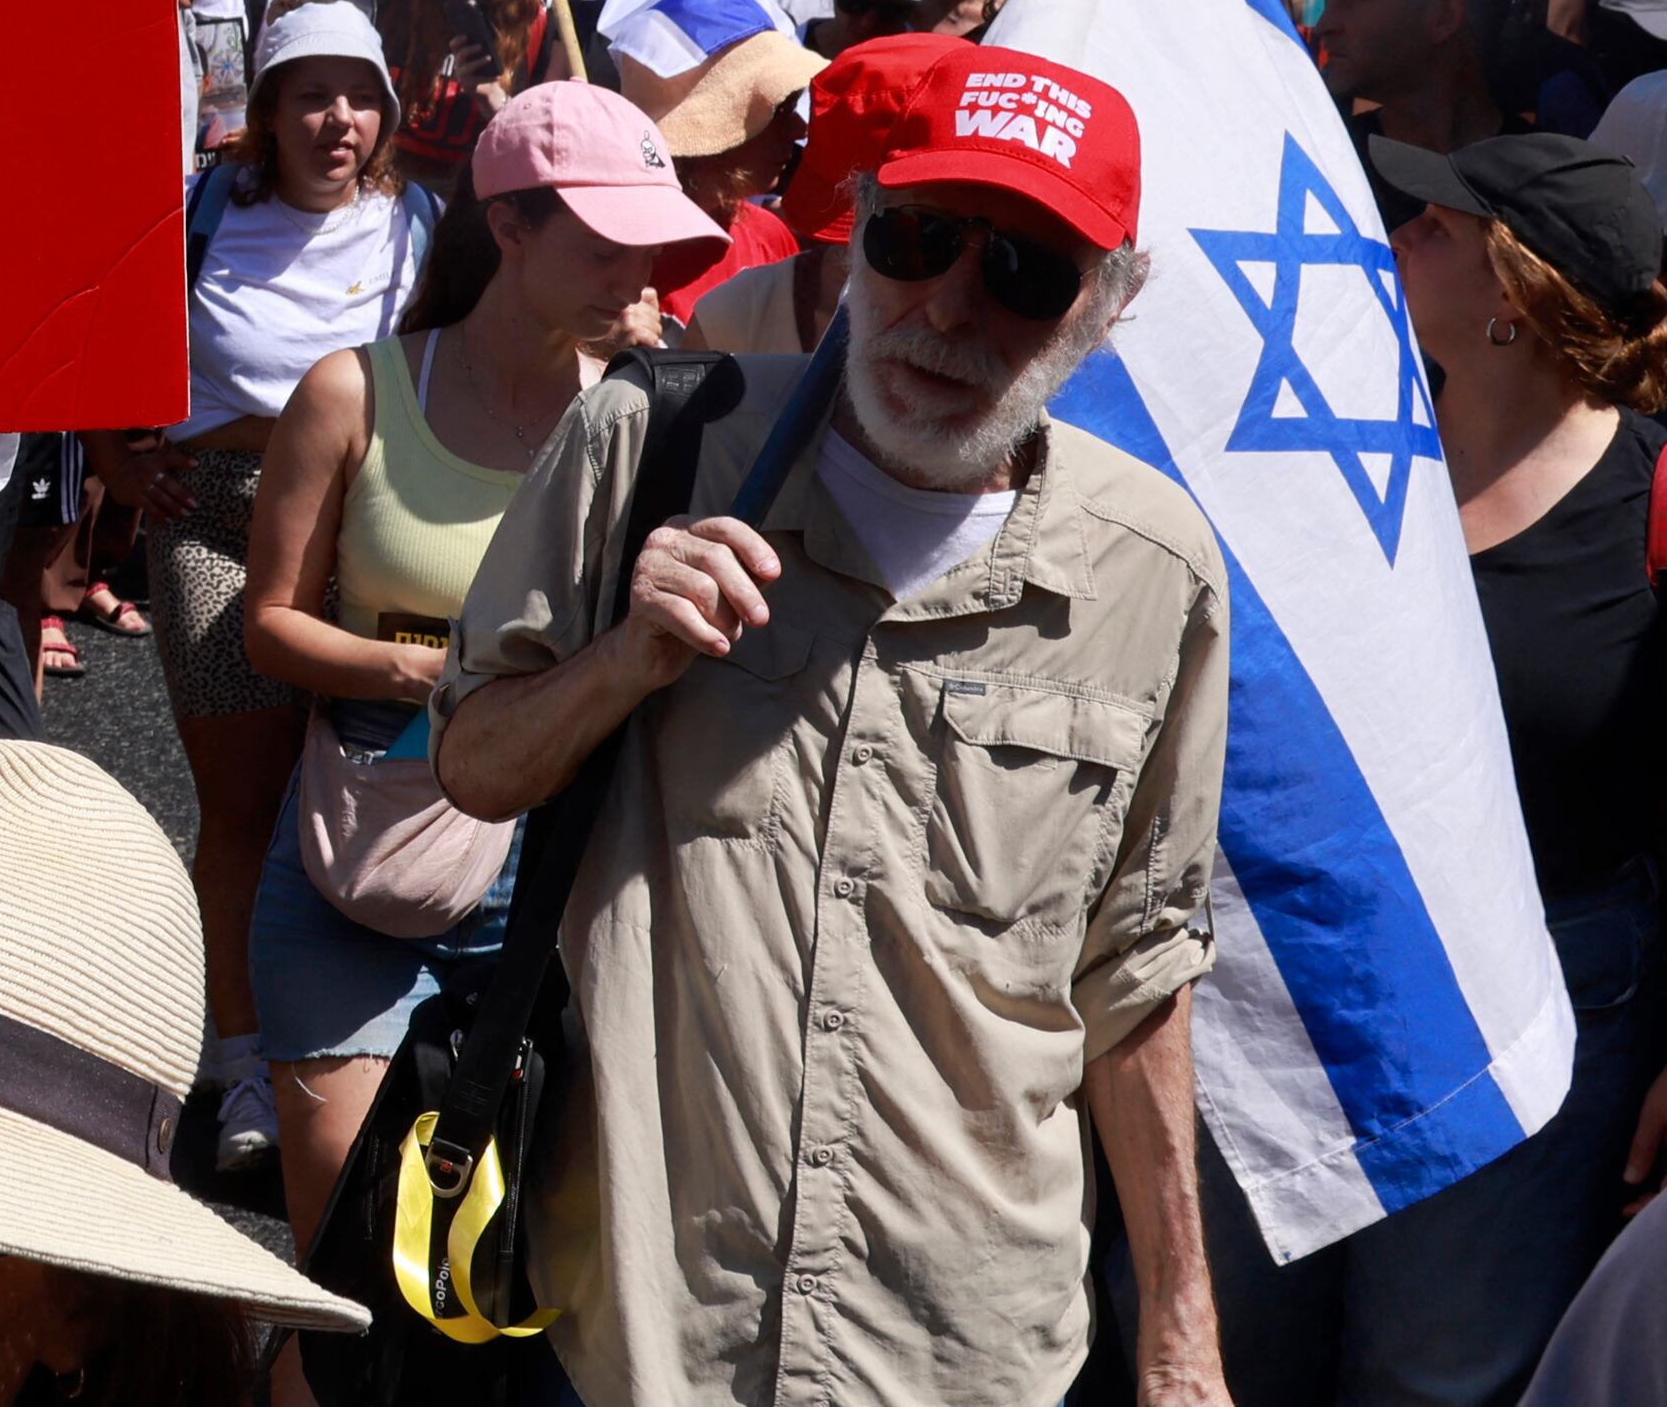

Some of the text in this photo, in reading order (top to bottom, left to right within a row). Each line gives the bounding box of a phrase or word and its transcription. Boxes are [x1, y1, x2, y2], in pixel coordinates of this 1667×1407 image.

[965, 73, 1092, 120] END THIS
[955, 109, 1077, 169] WAR
